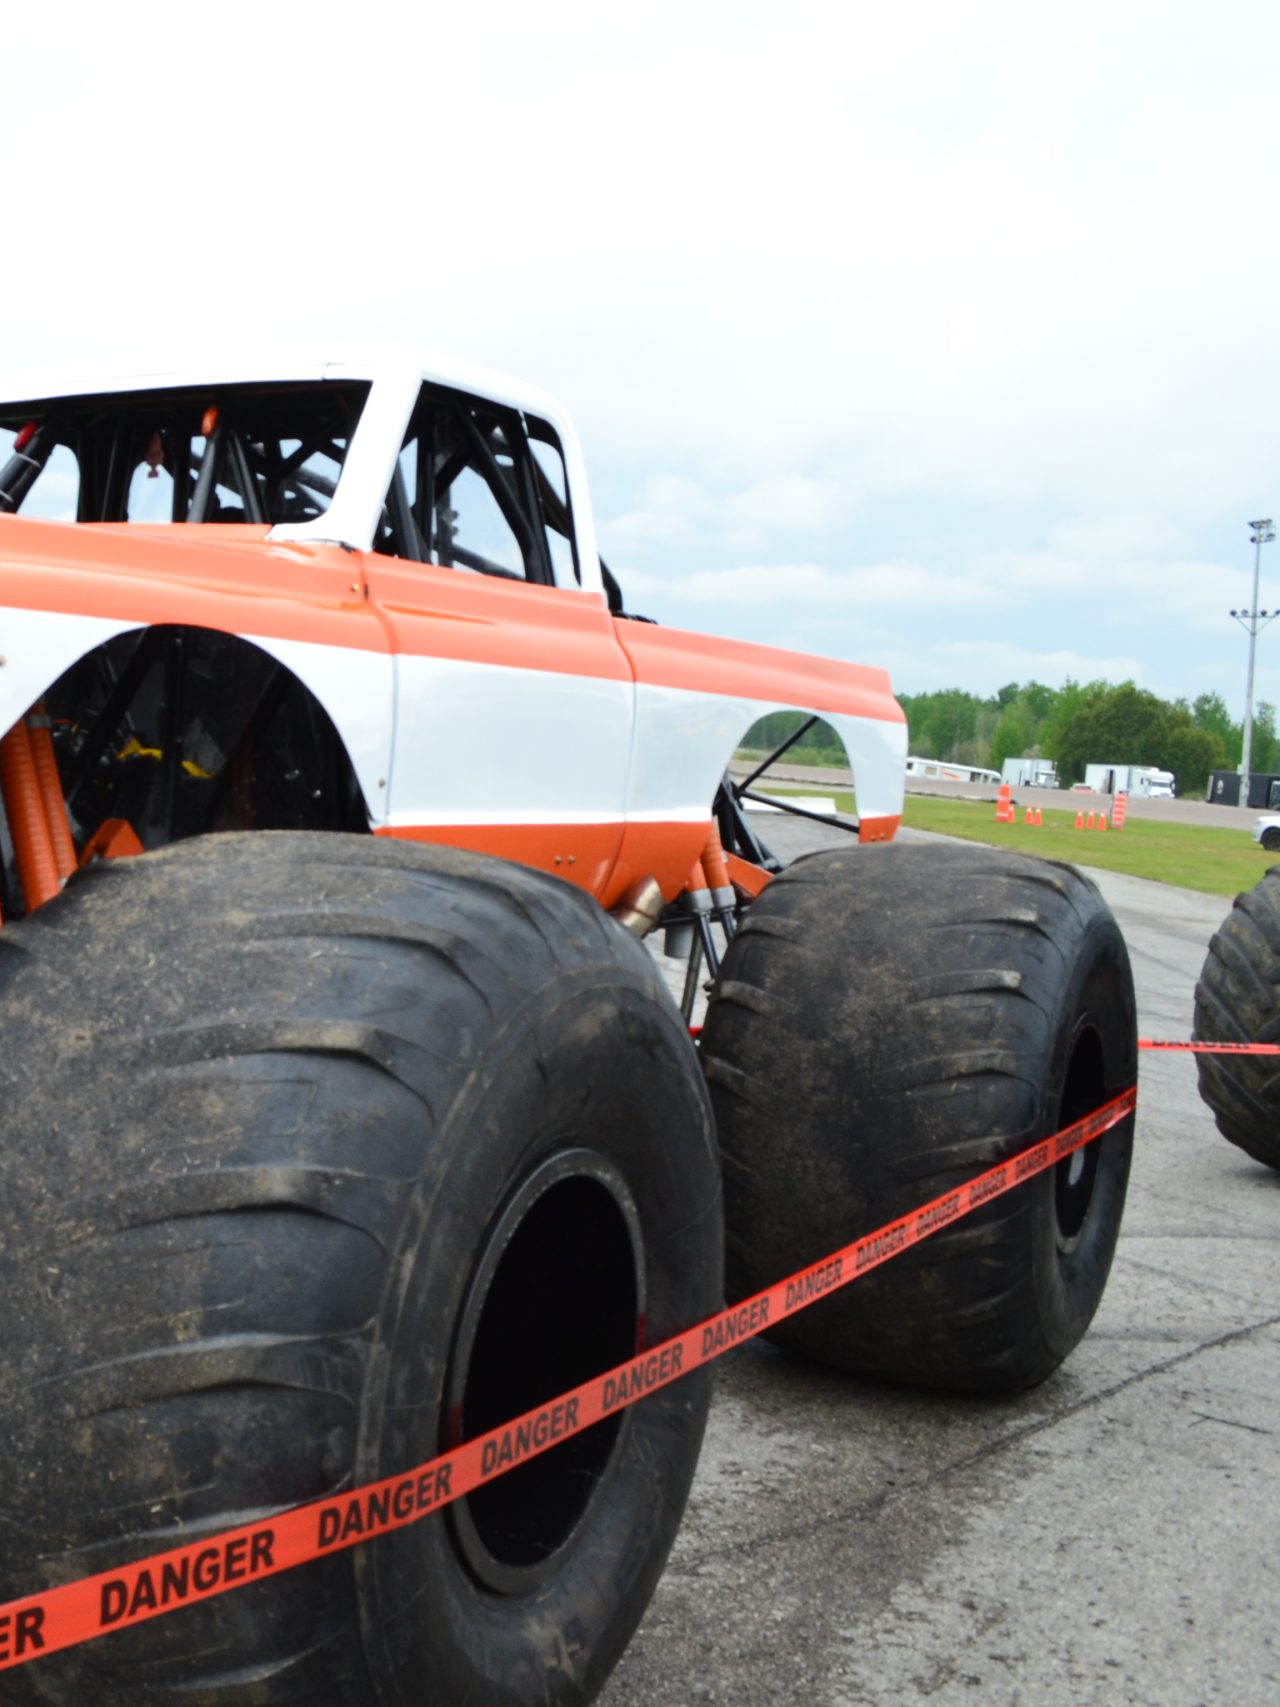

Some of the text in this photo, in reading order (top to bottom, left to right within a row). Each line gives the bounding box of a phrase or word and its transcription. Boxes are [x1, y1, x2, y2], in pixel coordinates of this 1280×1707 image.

[100, 1529, 276, 1626] DANGER
[317, 1462, 454, 1549] DANGER
[481, 1397, 580, 1476] DANGER
[602, 1343, 683, 1410] DANGER
[701, 1296, 770, 1358] DANGER
[785, 1258, 842, 1311] DANGER
[855, 1223, 906, 1272] DANGER
[916, 1194, 961, 1237] DANGER
